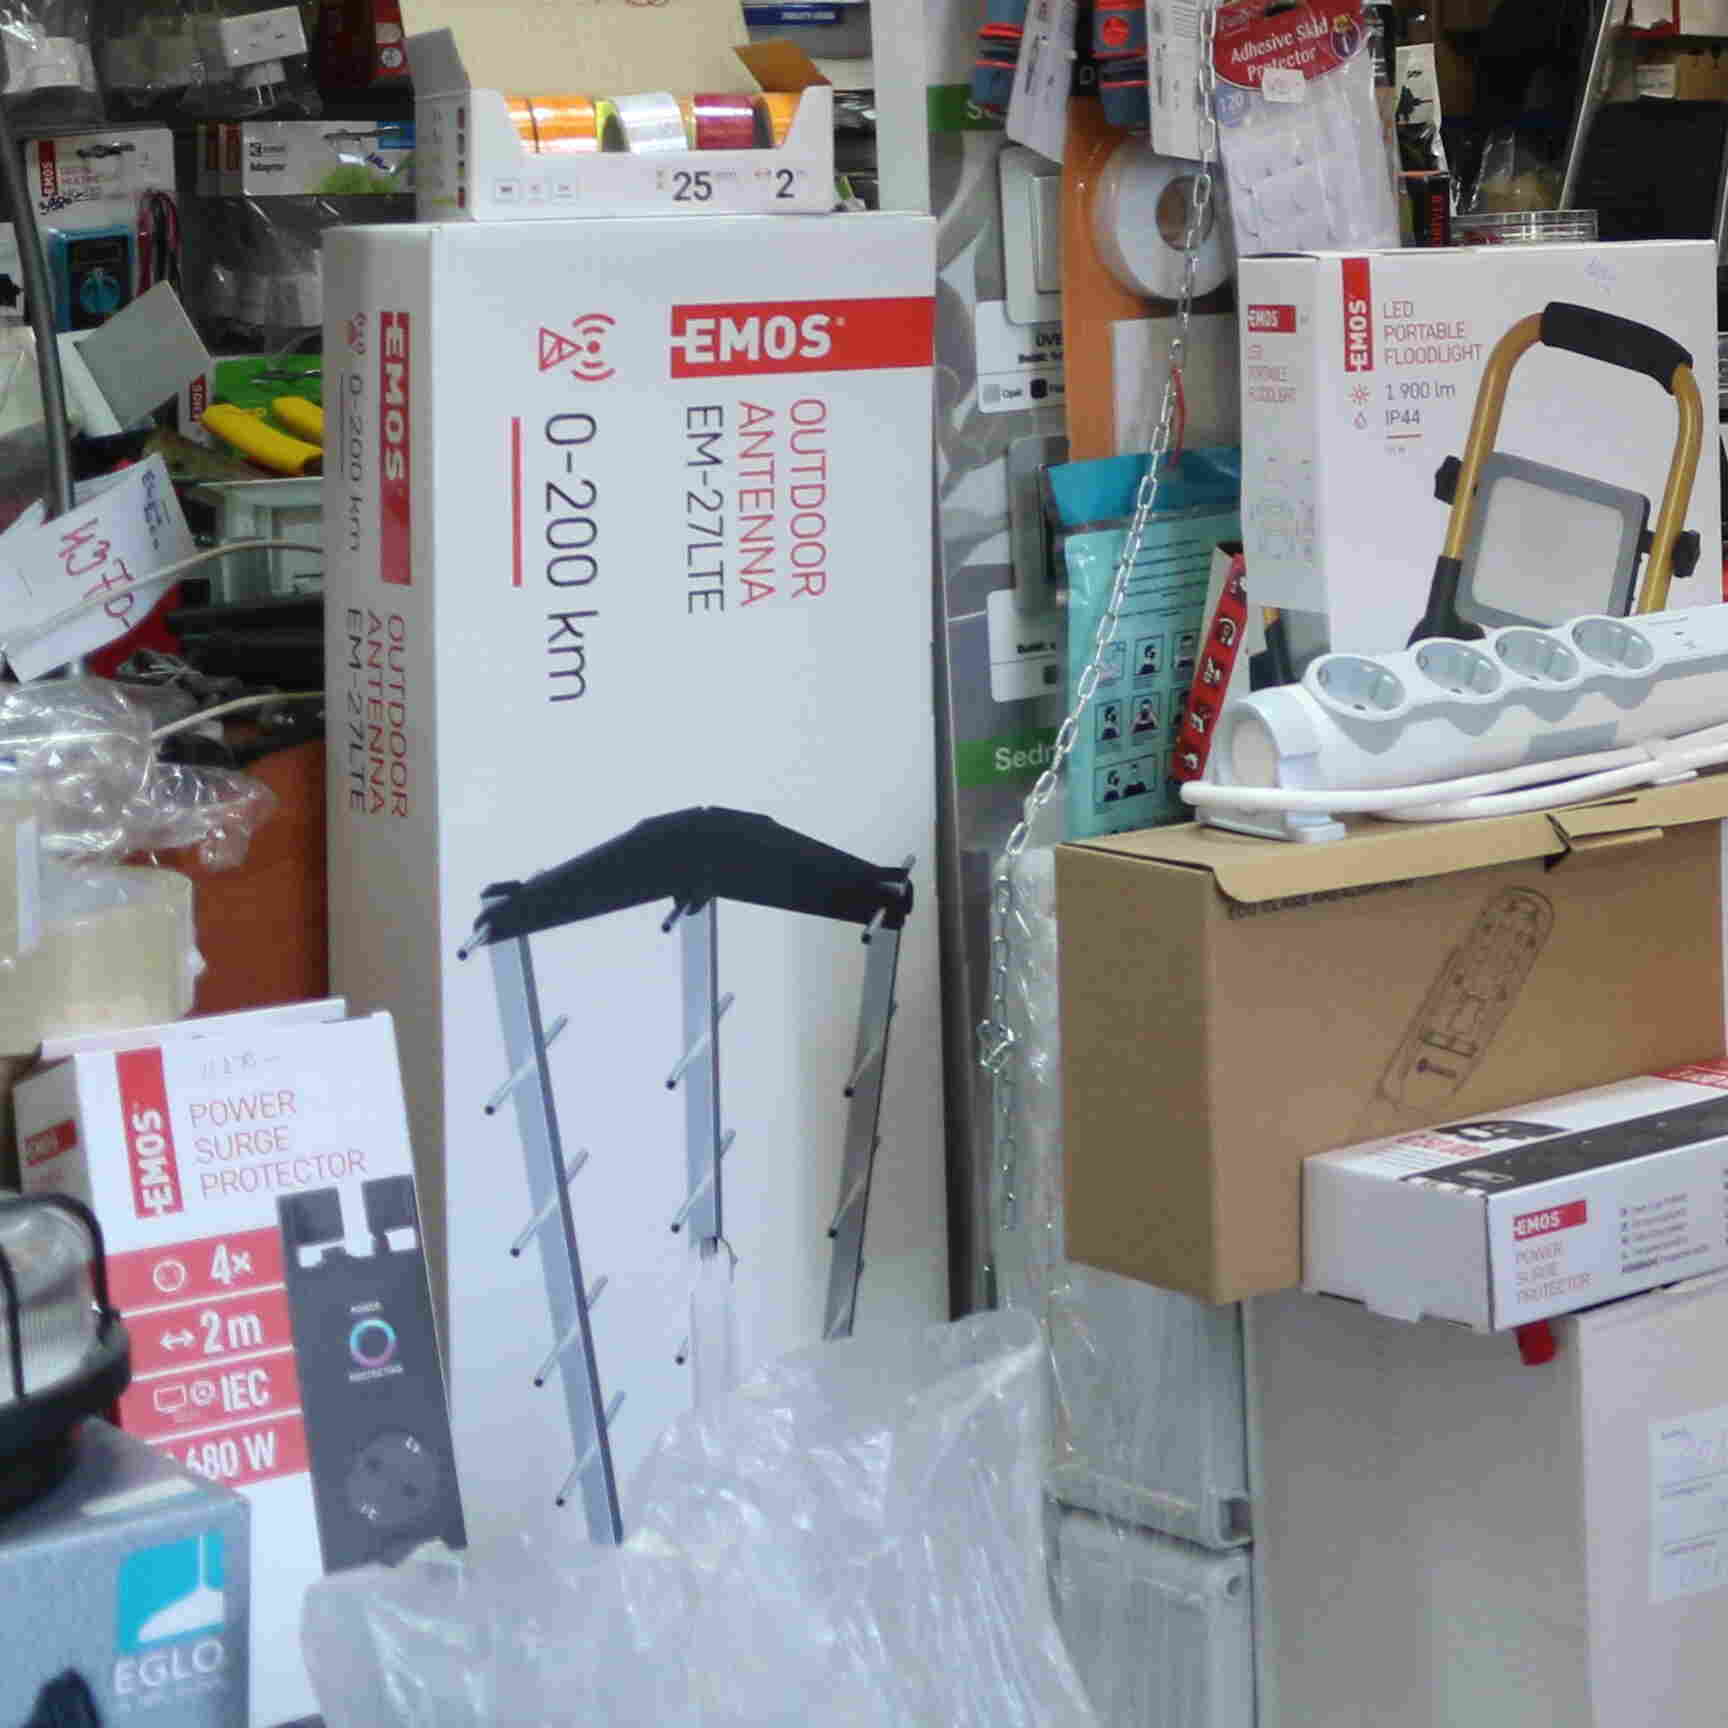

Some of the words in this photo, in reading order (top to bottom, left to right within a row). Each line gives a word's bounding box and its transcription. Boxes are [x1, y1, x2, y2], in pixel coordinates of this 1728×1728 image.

[1229, 30, 1296, 65] Adhesive
[1247, 48, 1317, 83] Protector
[673, 171, 713, 201] 25
[776, 168, 796, 199] 2
[686, 315, 834, 361] EMOS
[1346, 297, 1372, 369] EMOS
[1384, 301, 1415, 320] LED
[1384, 321, 1467, 341] PORTABLE
[1384, 343, 1484, 368] FLOODLIGHT
[382, 320, 406, 483] EMOS
[1400, 383, 1431, 401] 900
[1434, 382, 1457, 400] lm
[348, 373, 365, 483] 0-200
[1385, 409, 1422, 426] IP44
[544, 412, 599, 591] 0-200
[686, 404, 726, 614] EM-27LTE
[737, 401, 776, 607] ANTENNA
[789, 398, 828, 599] OUTDOOR
[547, 608, 599, 703] km
[347, 607, 368, 813] EM-27LTE
[366, 609, 386, 816] ANTENNA
[388, 612, 409, 821] OUTDOOR
[134, 1108, 177, 1217] EMOS
[189, 1088, 297, 1126] POWER
[193, 1126, 291, 1163] SURGE
[200, 1150, 369, 1200] PROTECTOR
[1516, 1212, 1563, 1239] EMOS
[1516, 1241, 1563, 1266] POWER
[218, 1365, 271, 1412] IEC
[245, 1427, 278, 1473] W
[113, 1639, 226, 1697] EGLO
